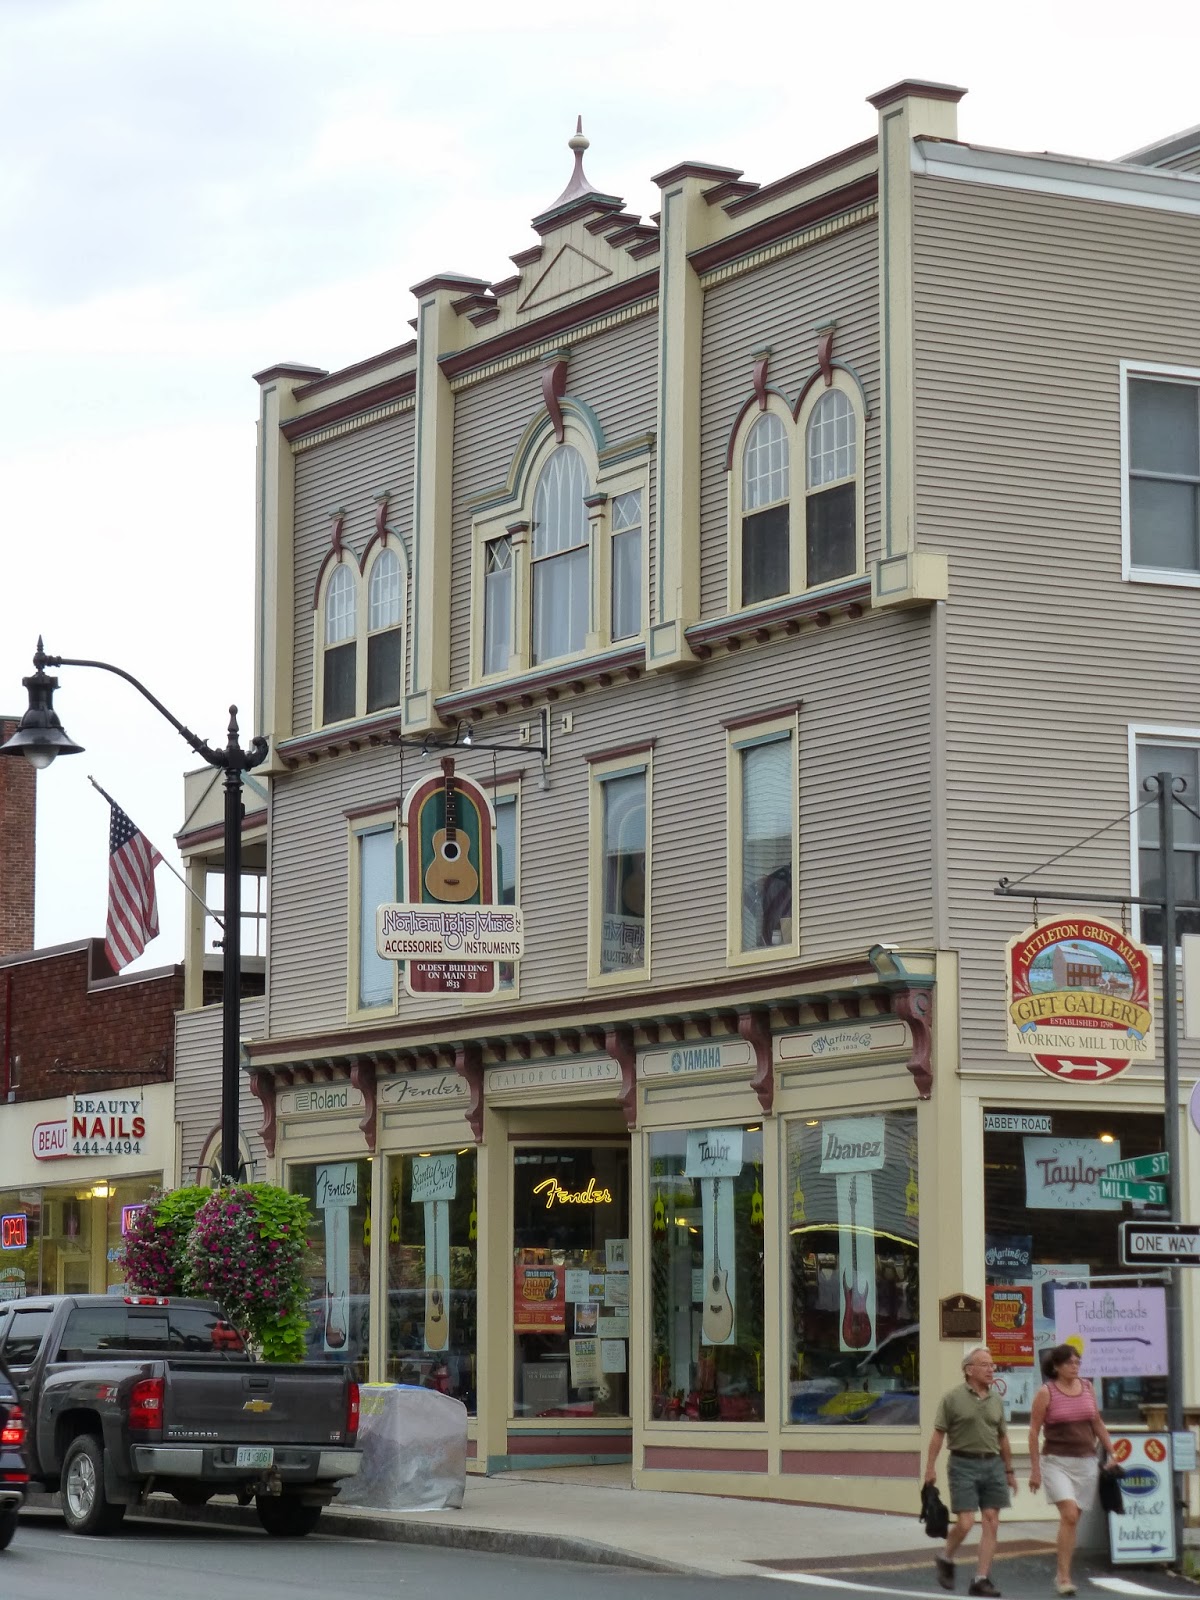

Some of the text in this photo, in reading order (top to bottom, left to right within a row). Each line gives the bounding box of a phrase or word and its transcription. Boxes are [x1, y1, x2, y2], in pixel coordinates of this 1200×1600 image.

[382, 910, 515, 950] Northern Lights Music
[385, 940, 520, 955] ACCESSORIES INSTRUMENTS
[1019, 924, 1142, 974] LITTLETON GRIST MILL
[417, 964, 488, 972] OLDEST BUILDING
[428, 972, 440, 980] ON
[443, 972, 466, 980] MAIN
[446, 980, 460, 989] 1833
[1018, 994, 1143, 1027] GIFT GALLERY
[1050, 1018, 1114, 1029] ESTABLISHED 1798
[1016, 1032, 1148, 1052] WORKING MILL TOURS
[682, 1047, 721, 1070] YAMAHA
[496, 1064, 612, 1087] TAYLOR GUITARS
[310, 1088, 348, 1110] Roland
[385, 1076, 463, 1102] Fender
[74, 1100, 141, 1113] BEAUTY
[72, 1116, 146, 1138] NAILS
[988, 1117, 1047, 1130] ABBEY ROAD
[73, 1141, 141, 1154] 444-4494
[699, 1139, 730, 1165] Taylor
[823, 1133, 882, 1161] Ibanez
[412, 1160, 455, 1190] Santa Cruz
[1110, 1155, 1166, 1179] MAIN ST
[317, 1167, 356, 1204] Fender
[533, 1177, 612, 1209] Fender
[1102, 1181, 1164, 1202] MILL ST
[4, 1218, 27, 1246] OPEN
[1135, 1236, 1196, 1251] ONE WAY
[526, 1280, 549, 1288] ROAD
[995, 1304, 1017, 1312] ROAD
[1075, 1300, 1147, 1322] Fiddleheads
[1124, 1501, 1164, 1519] afé &
[1119, 1526, 1166, 1541] bakery
